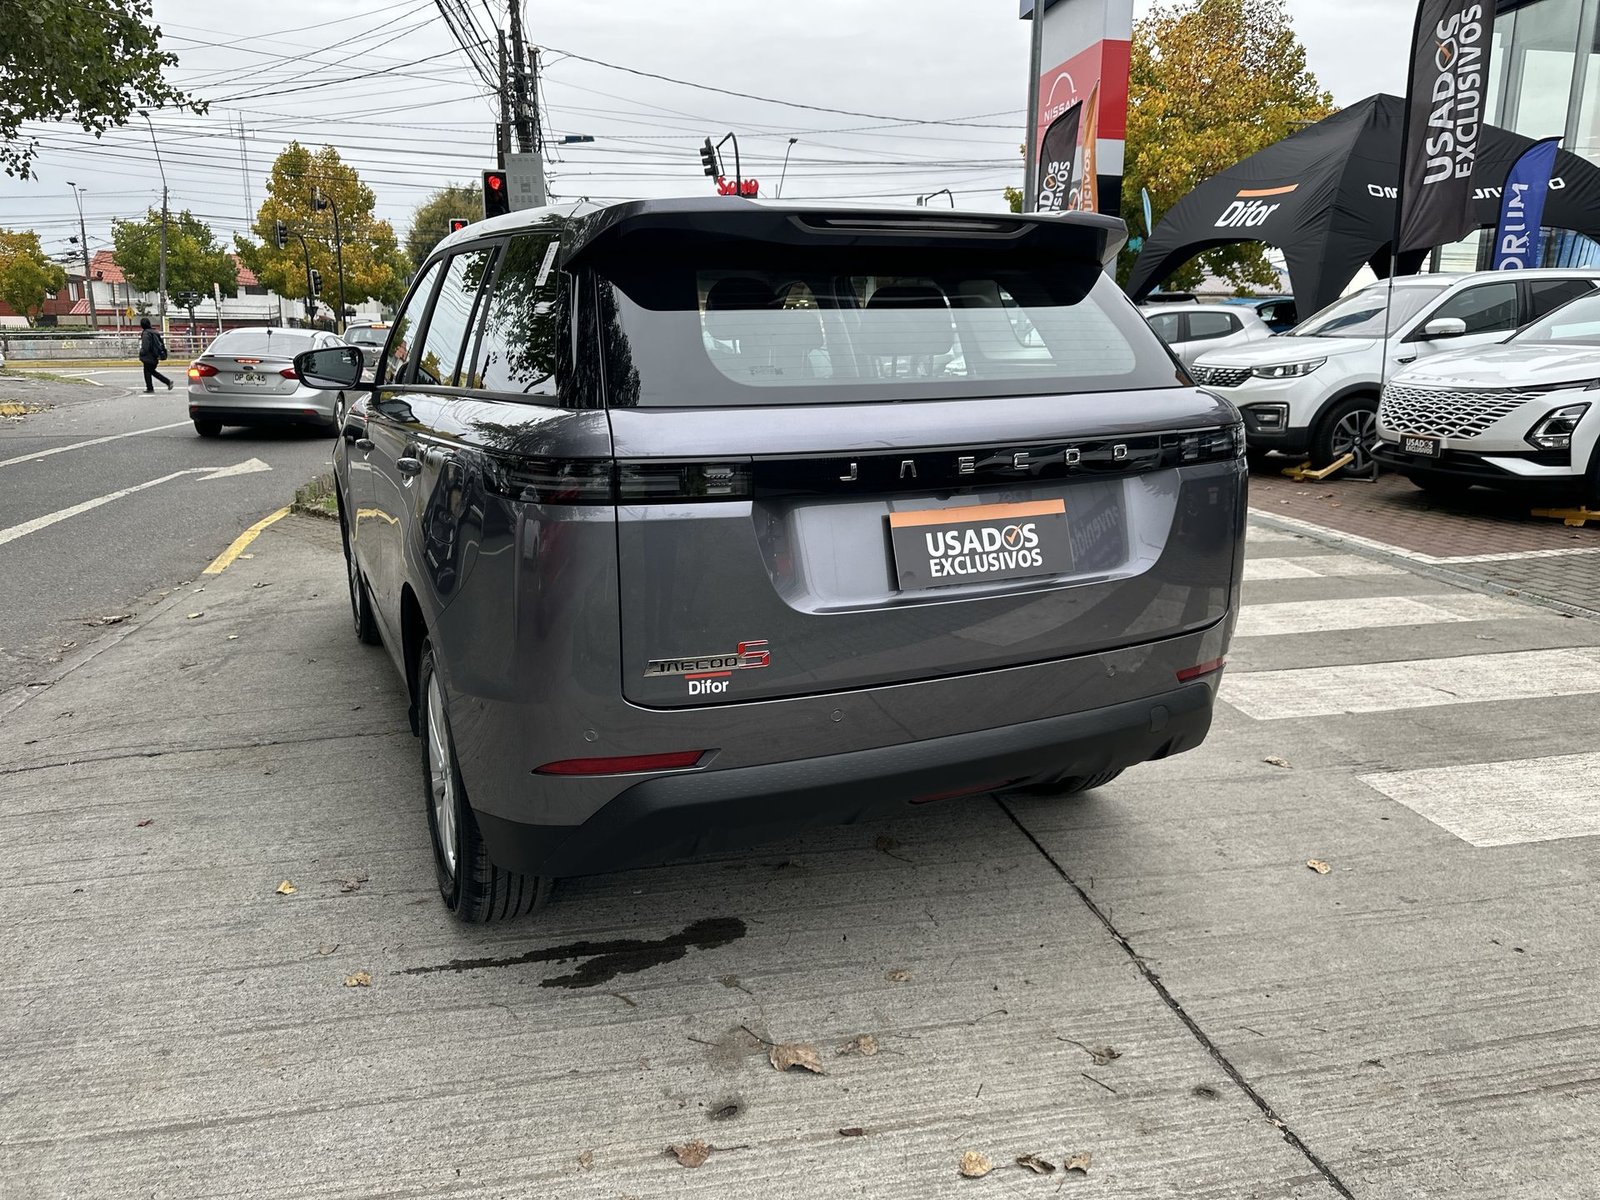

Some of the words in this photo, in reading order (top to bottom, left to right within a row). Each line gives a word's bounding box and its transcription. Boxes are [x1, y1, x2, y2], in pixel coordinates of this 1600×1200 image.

[1423, 13, 1461, 185] USADOS
[1213, 200, 1281, 228] Difor
[1405, 438, 1434, 449] USADOS
[839, 444, 1129, 482] JAECOO
[925, 522, 1039, 558] USADOS
[929, 548, 1043, 578] EXCLUSIVOS
[652, 656, 738, 673] JAECOO
[688, 680, 730, 696] Difor
